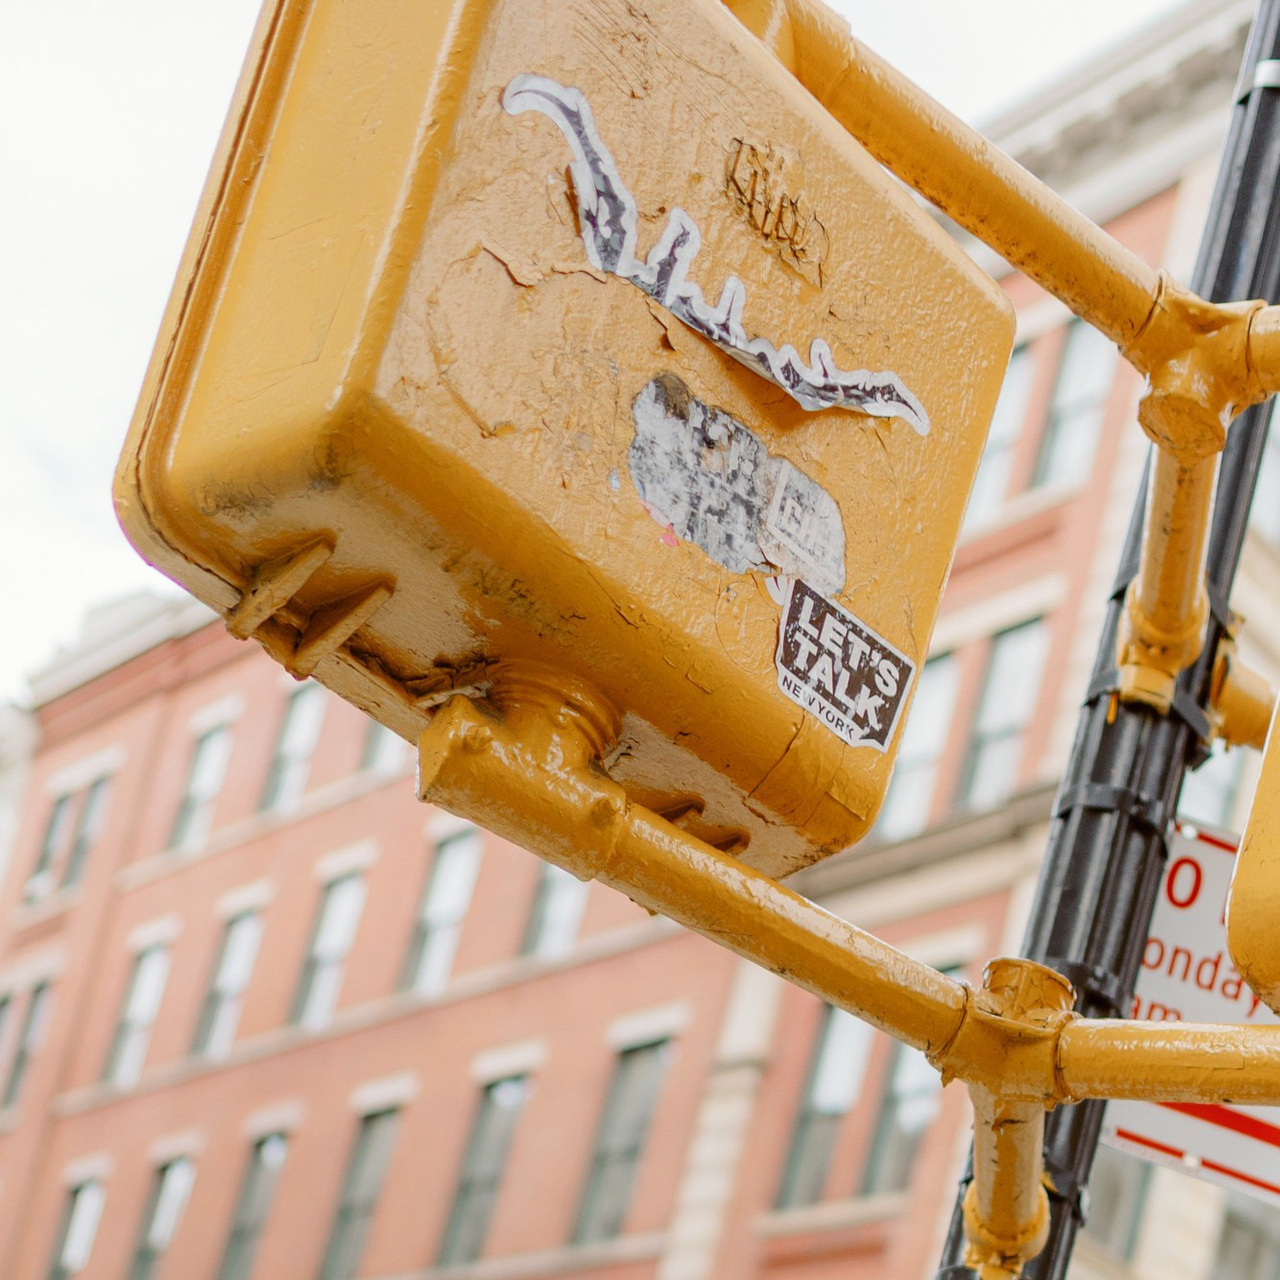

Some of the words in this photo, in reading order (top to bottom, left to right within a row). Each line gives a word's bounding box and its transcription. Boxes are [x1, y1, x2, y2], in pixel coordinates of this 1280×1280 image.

[793, 630, 906, 732] TALK
[799, 595, 900, 698] LET'S
[817, 700, 855, 740] YORK
[1166, 856, 1204, 909] O
[1142, 937, 1260, 1019] onday
